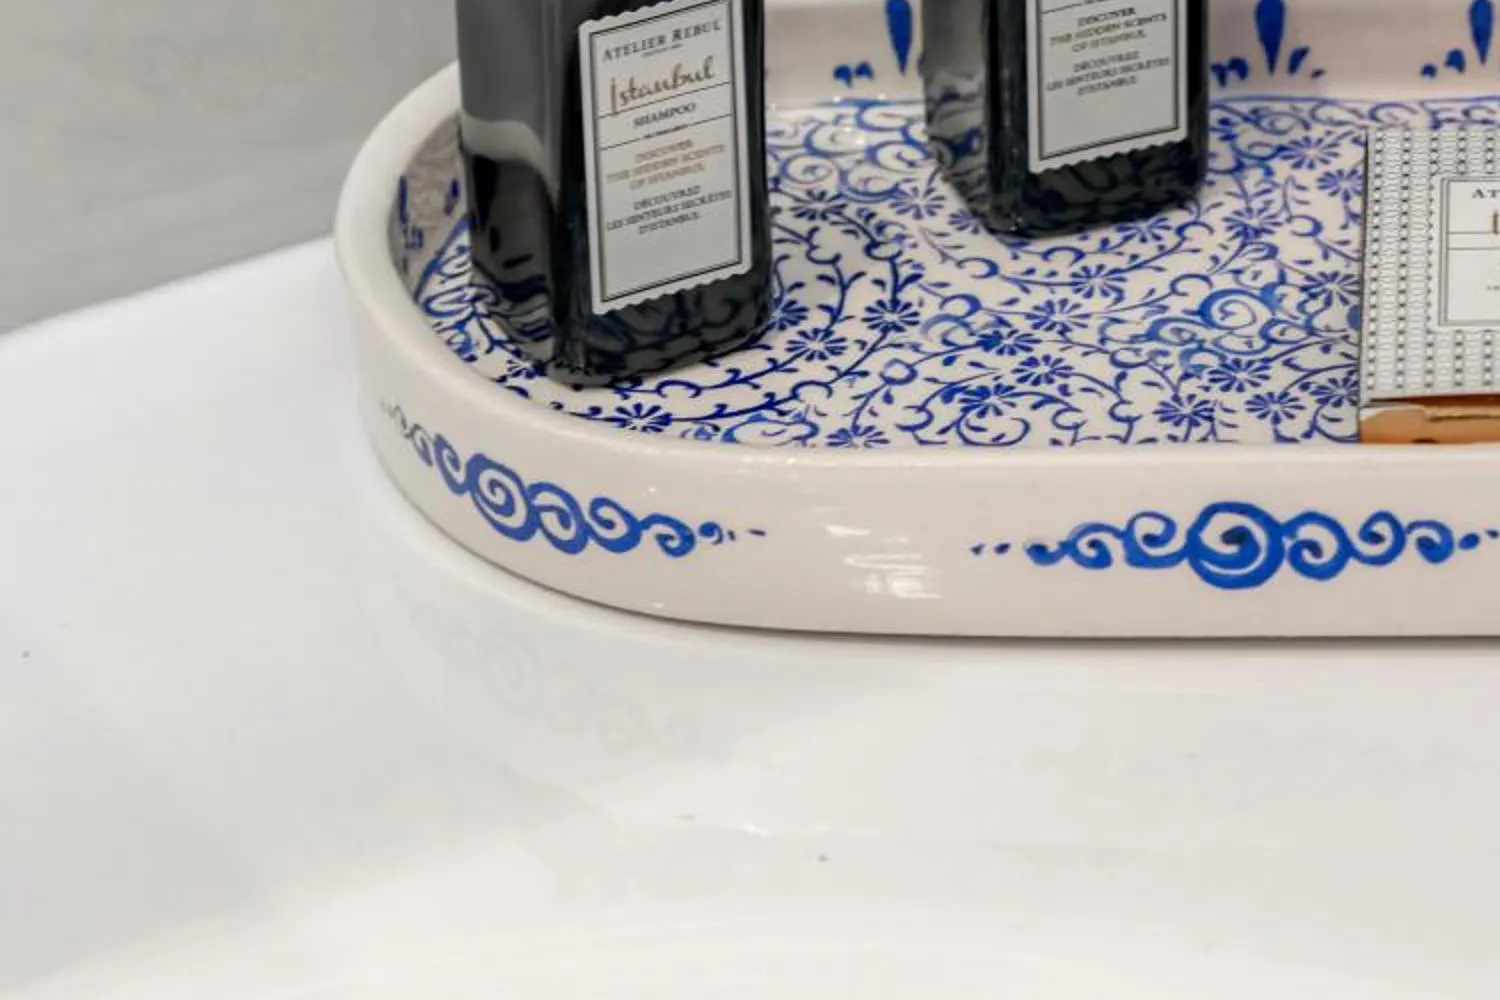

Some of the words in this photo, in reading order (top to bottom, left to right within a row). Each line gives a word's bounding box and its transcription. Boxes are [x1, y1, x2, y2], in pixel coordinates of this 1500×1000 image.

[602, 34, 665, 61] ATELIER
[672, 19, 721, 42] REBUL
[633, 102, 696, 127] SHAMPOO
